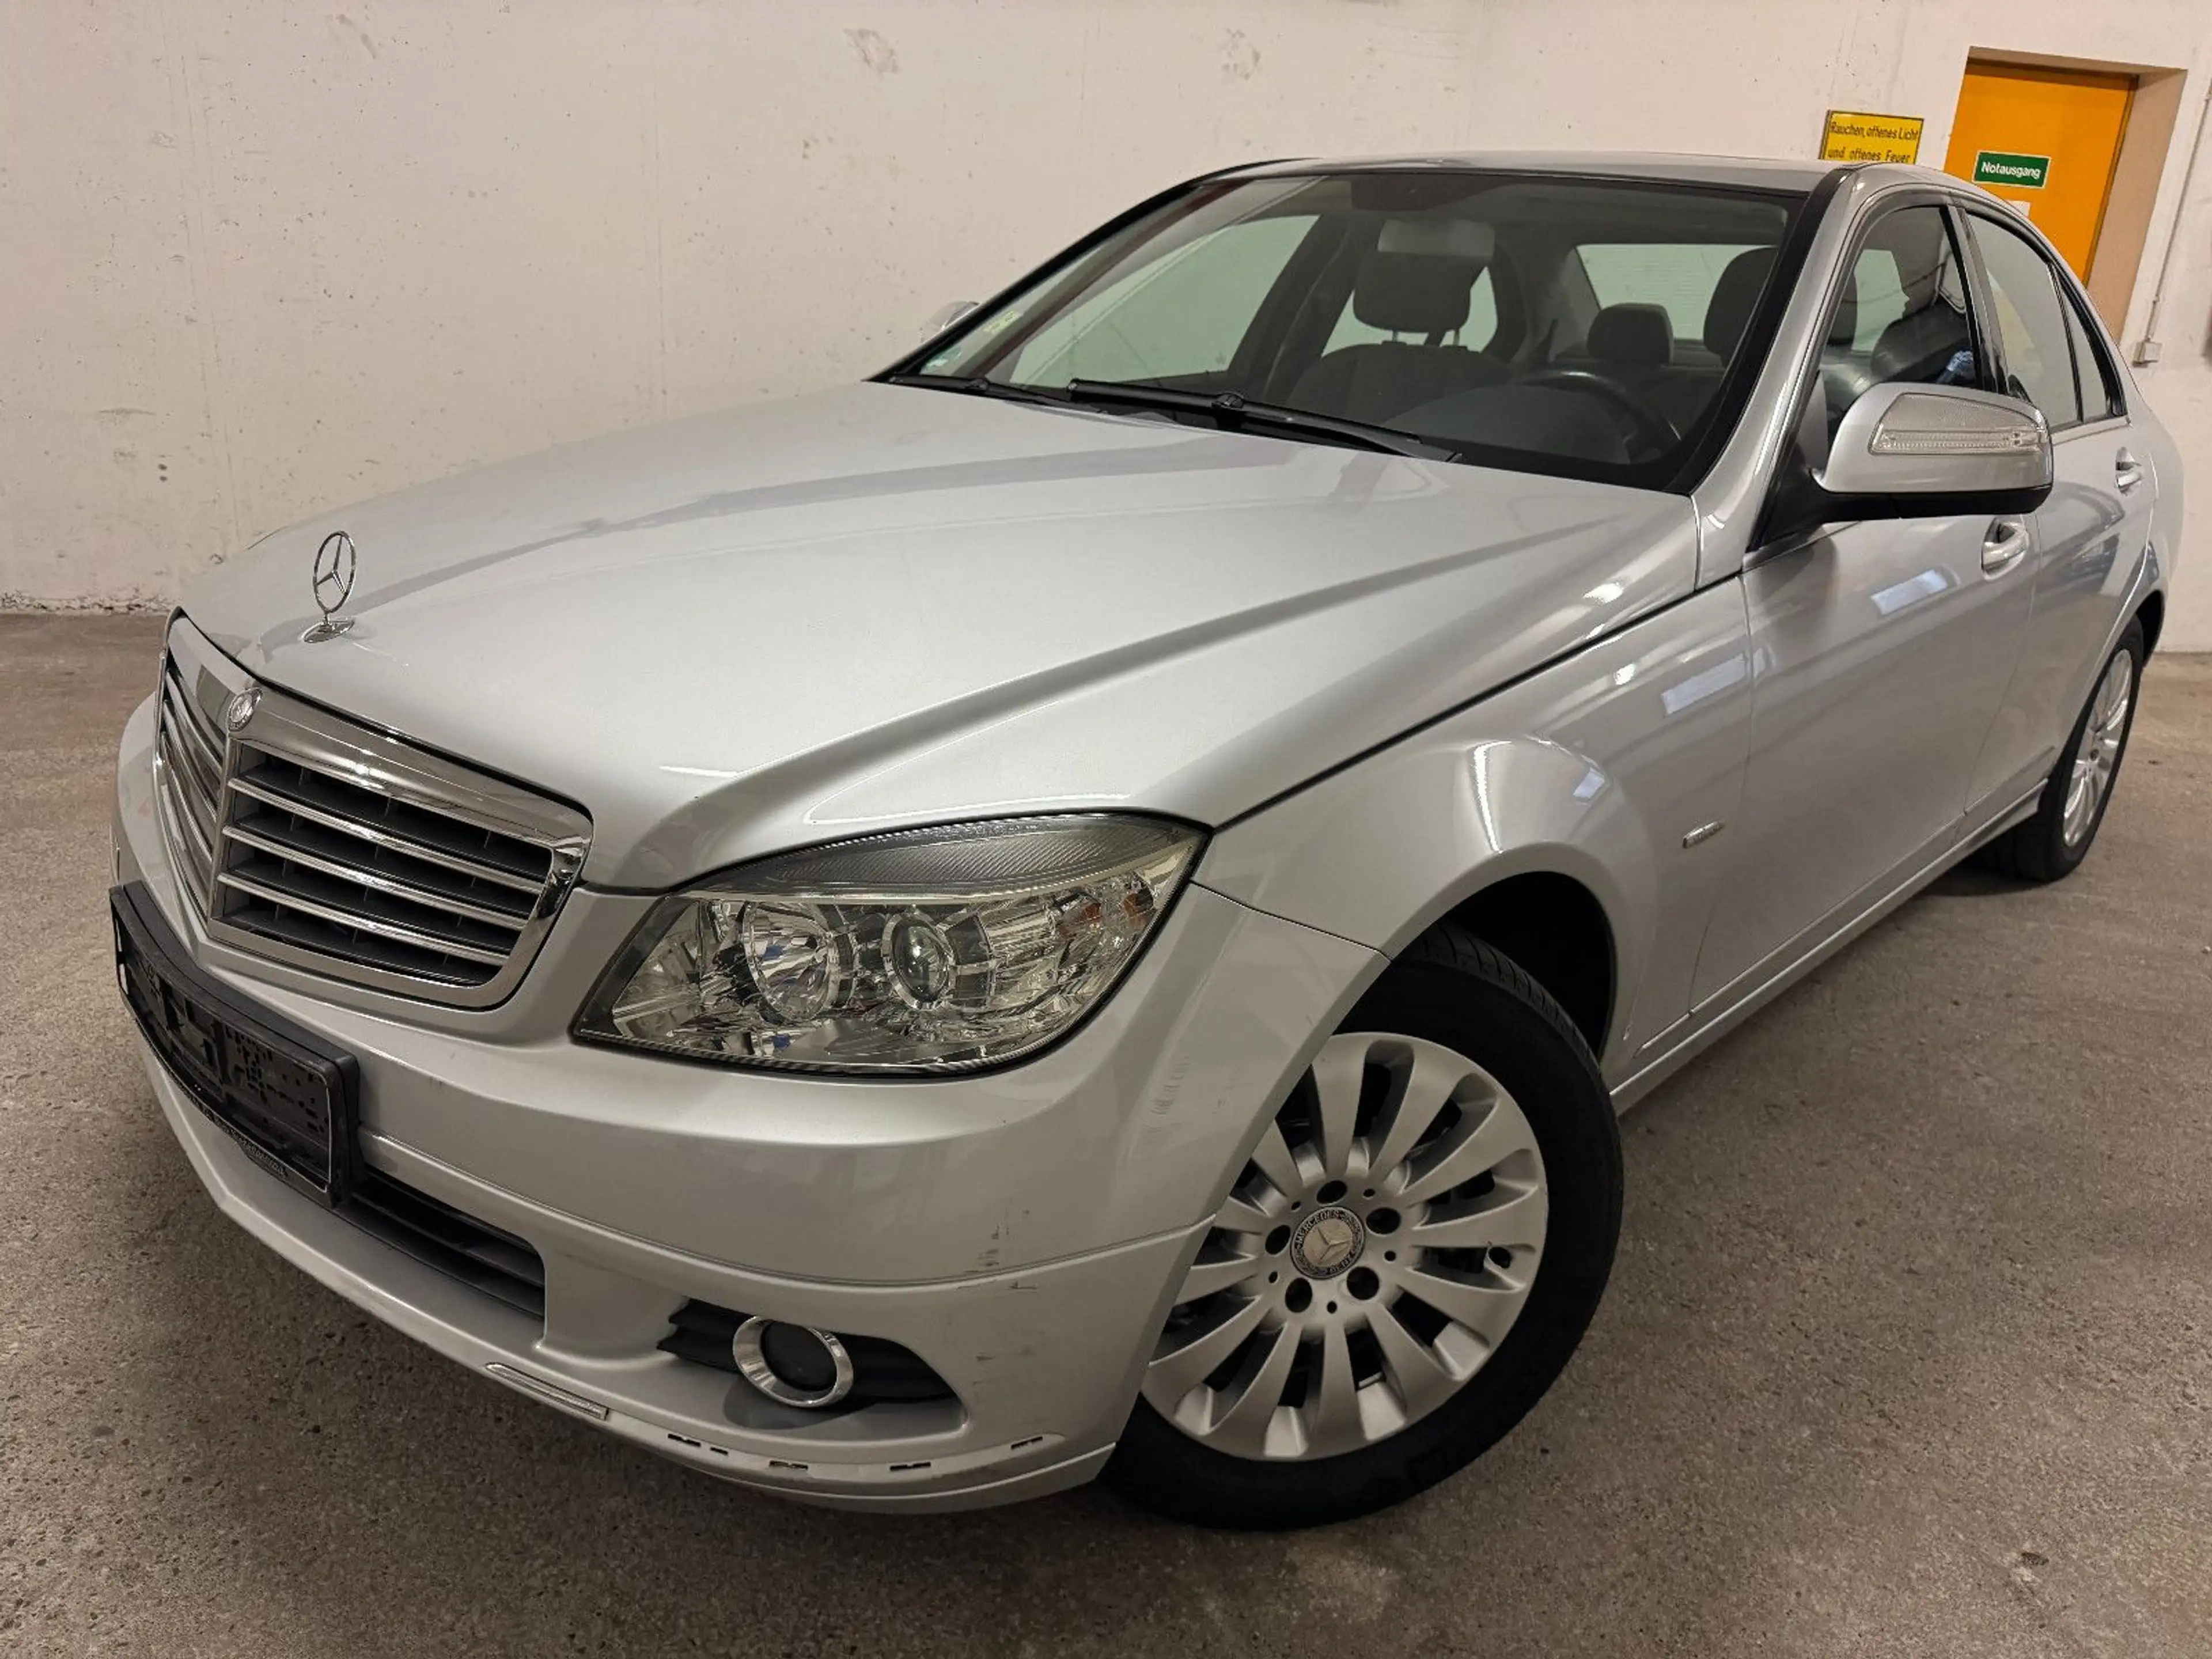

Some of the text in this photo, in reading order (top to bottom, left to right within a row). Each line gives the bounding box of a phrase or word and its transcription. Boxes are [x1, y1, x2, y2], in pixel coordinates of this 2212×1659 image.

[1898, 127, 1918, 140] Licht
[1828, 147, 1846, 158] und
[1982, 161, 2041, 180] Notausgang
